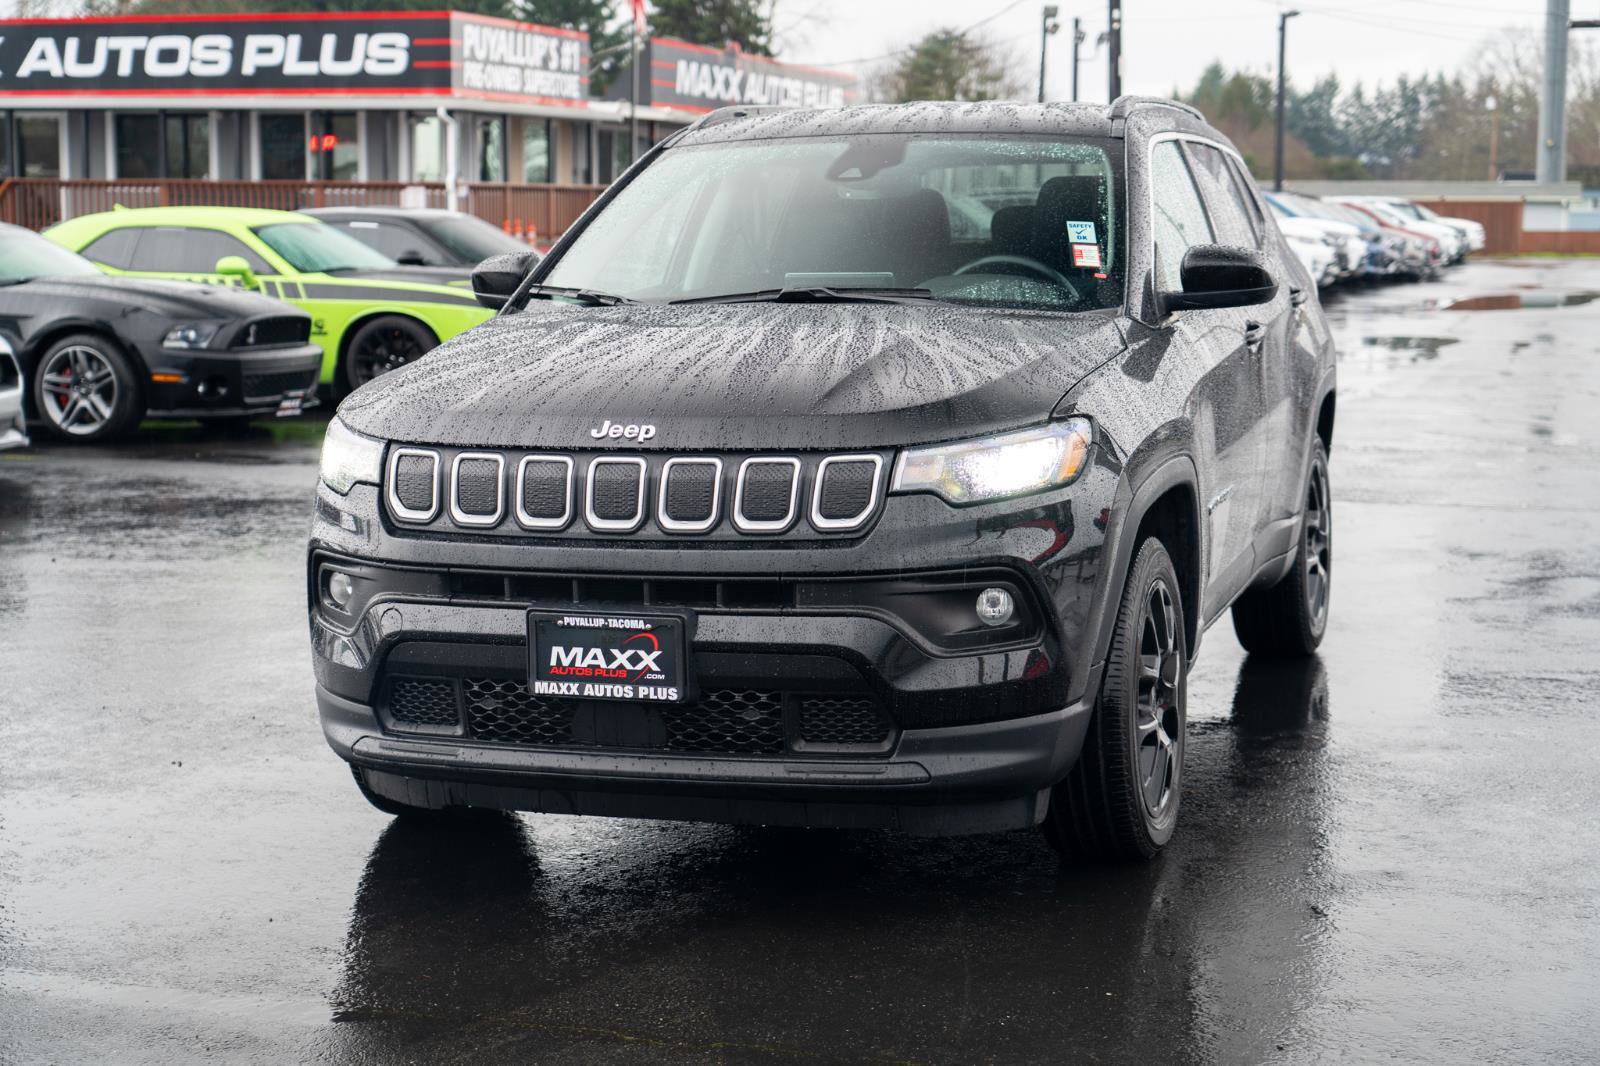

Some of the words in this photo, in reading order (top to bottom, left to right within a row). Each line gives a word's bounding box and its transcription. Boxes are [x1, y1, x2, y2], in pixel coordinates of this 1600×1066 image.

[15, 35, 233, 78] AUTOS
[241, 32, 411, 77] PLUS
[675, 58, 744, 102] MAXX
[590, 420, 656, 443] Jeep
[550, 646, 662, 671] MAXX
[549, 667, 593, 676] AUTOS
[594, 670, 628, 678] PLUS
[534, 681, 579, 695] MAXX
[583, 685, 634, 698] AUTOS
[638, 687, 678, 700] PLUS
